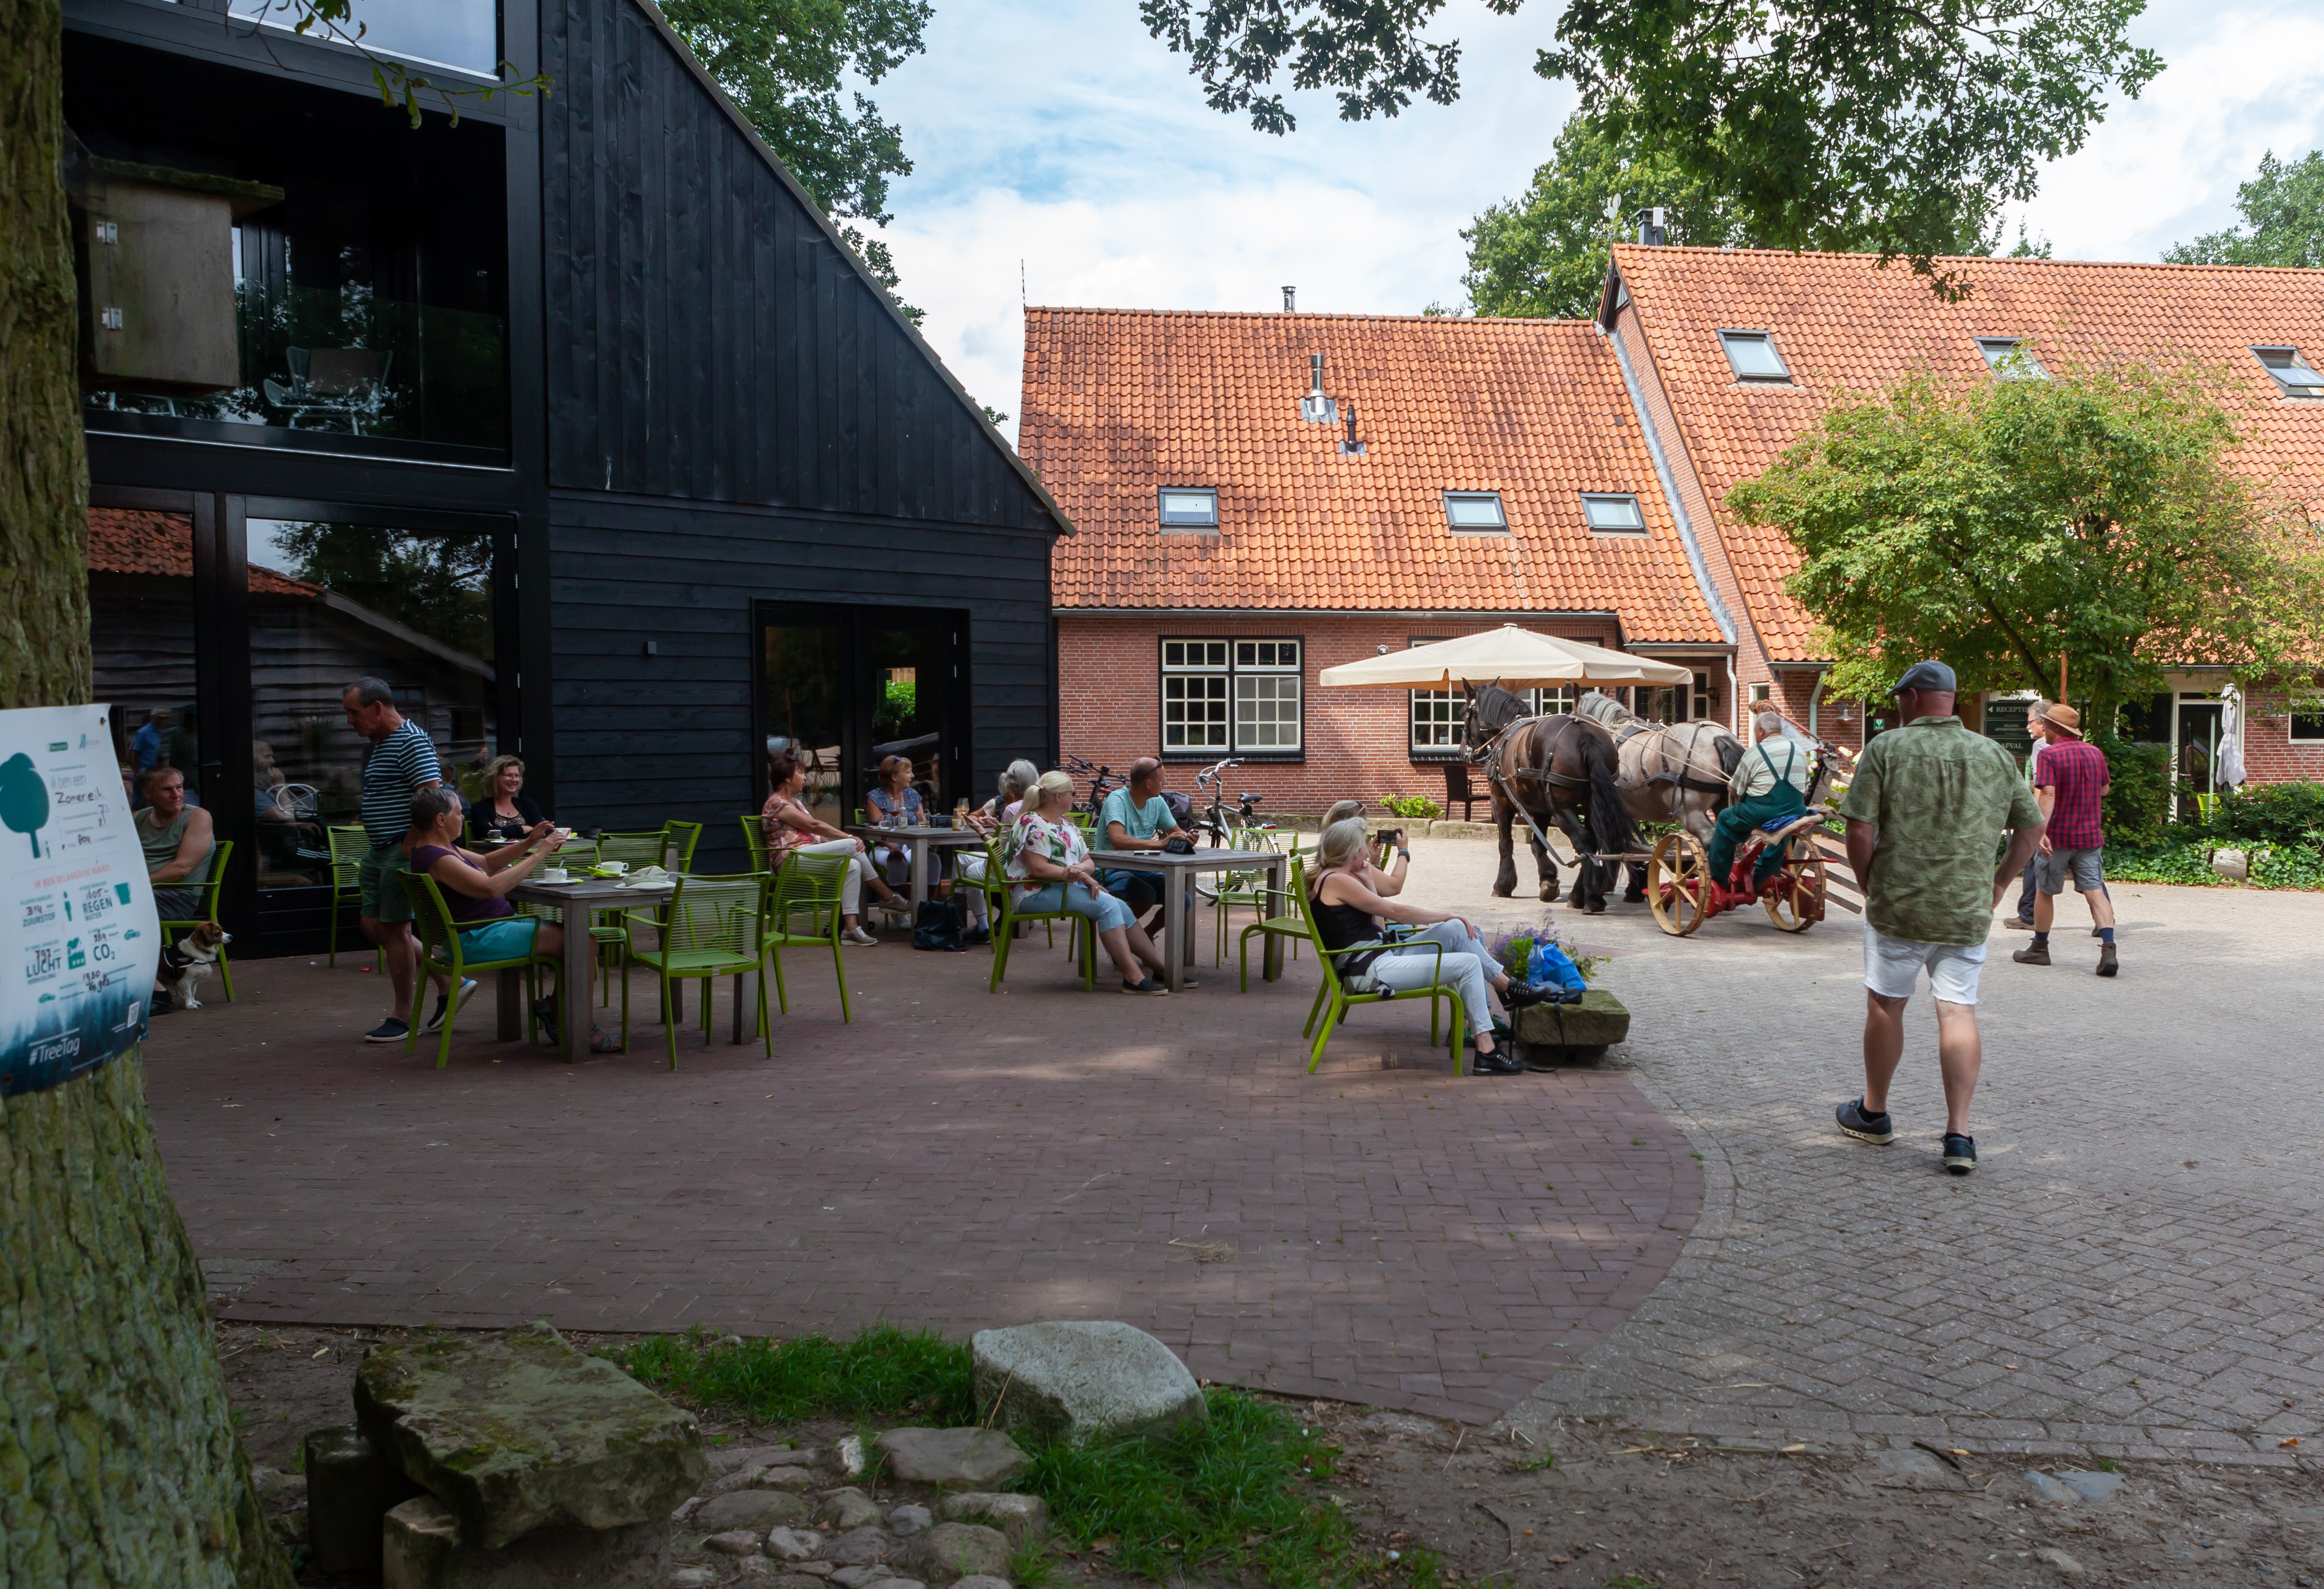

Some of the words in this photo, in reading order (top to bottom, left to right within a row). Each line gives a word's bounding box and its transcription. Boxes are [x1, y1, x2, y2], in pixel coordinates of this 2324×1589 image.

[58, 774, 72, 788] ben
[73, 775, 87, 787] een
[34, 880, 41, 889] IK
[42, 876, 55, 887] BEN
[83, 897, 113, 914] REGEN
[23, 912, 56, 928] ZUURSTOF
[27, 957, 62, 978] LUCHT
[29, 1037, 80, 1066] #TreeTag
